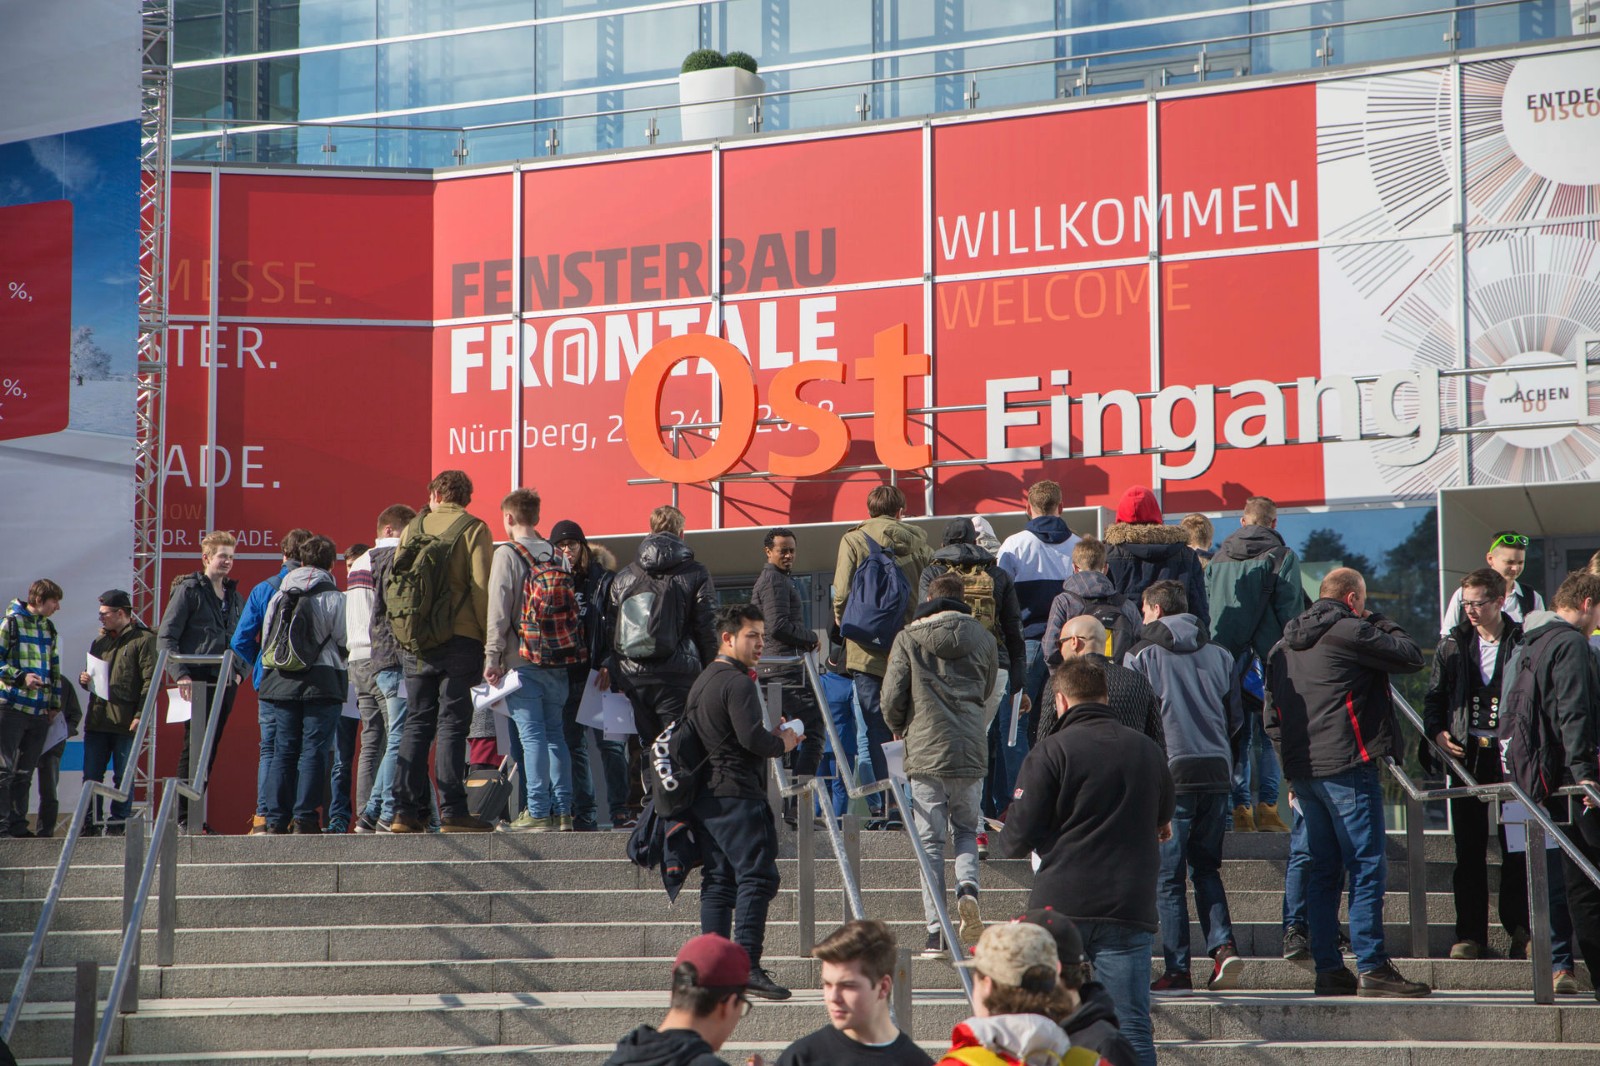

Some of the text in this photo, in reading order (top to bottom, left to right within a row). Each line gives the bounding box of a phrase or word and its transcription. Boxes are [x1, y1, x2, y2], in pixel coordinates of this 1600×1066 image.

[937, 179, 1299, 261] WILLKOMMEN
[451, 227, 837, 319] FENSTERBAU
[938, 262, 1192, 330] WELCOME
[624, 322, 931, 484] Ost
[985, 367, 1441, 480] Eingang
[1500, 386, 1569, 404] ACHEN
[1522, 399, 1547, 413] DO
[449, 419, 597, 455] Nürnberg,
